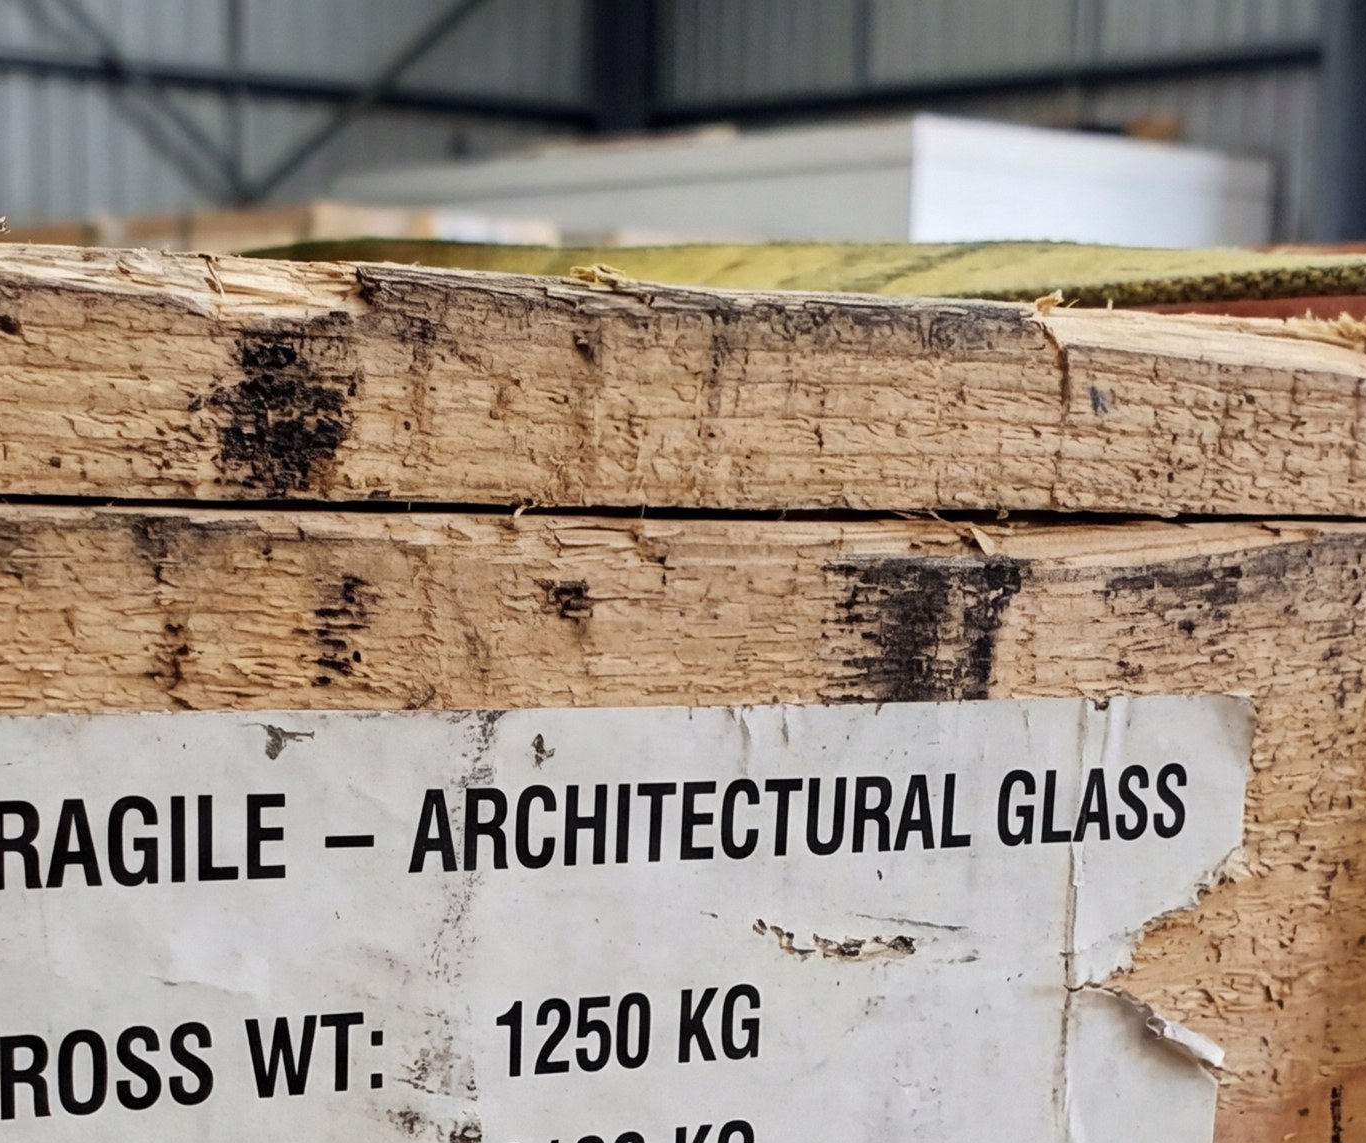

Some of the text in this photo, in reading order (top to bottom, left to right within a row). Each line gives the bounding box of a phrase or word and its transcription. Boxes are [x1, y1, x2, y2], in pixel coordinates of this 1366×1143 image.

[408, 773, 972, 874] ARCHITECTURAL
[997, 762, 1187, 847] GLASS
[245, 1011, 384, 1099] WT:
[496, 992, 651, 1078] 1250
[678, 983, 762, 1064] KG
